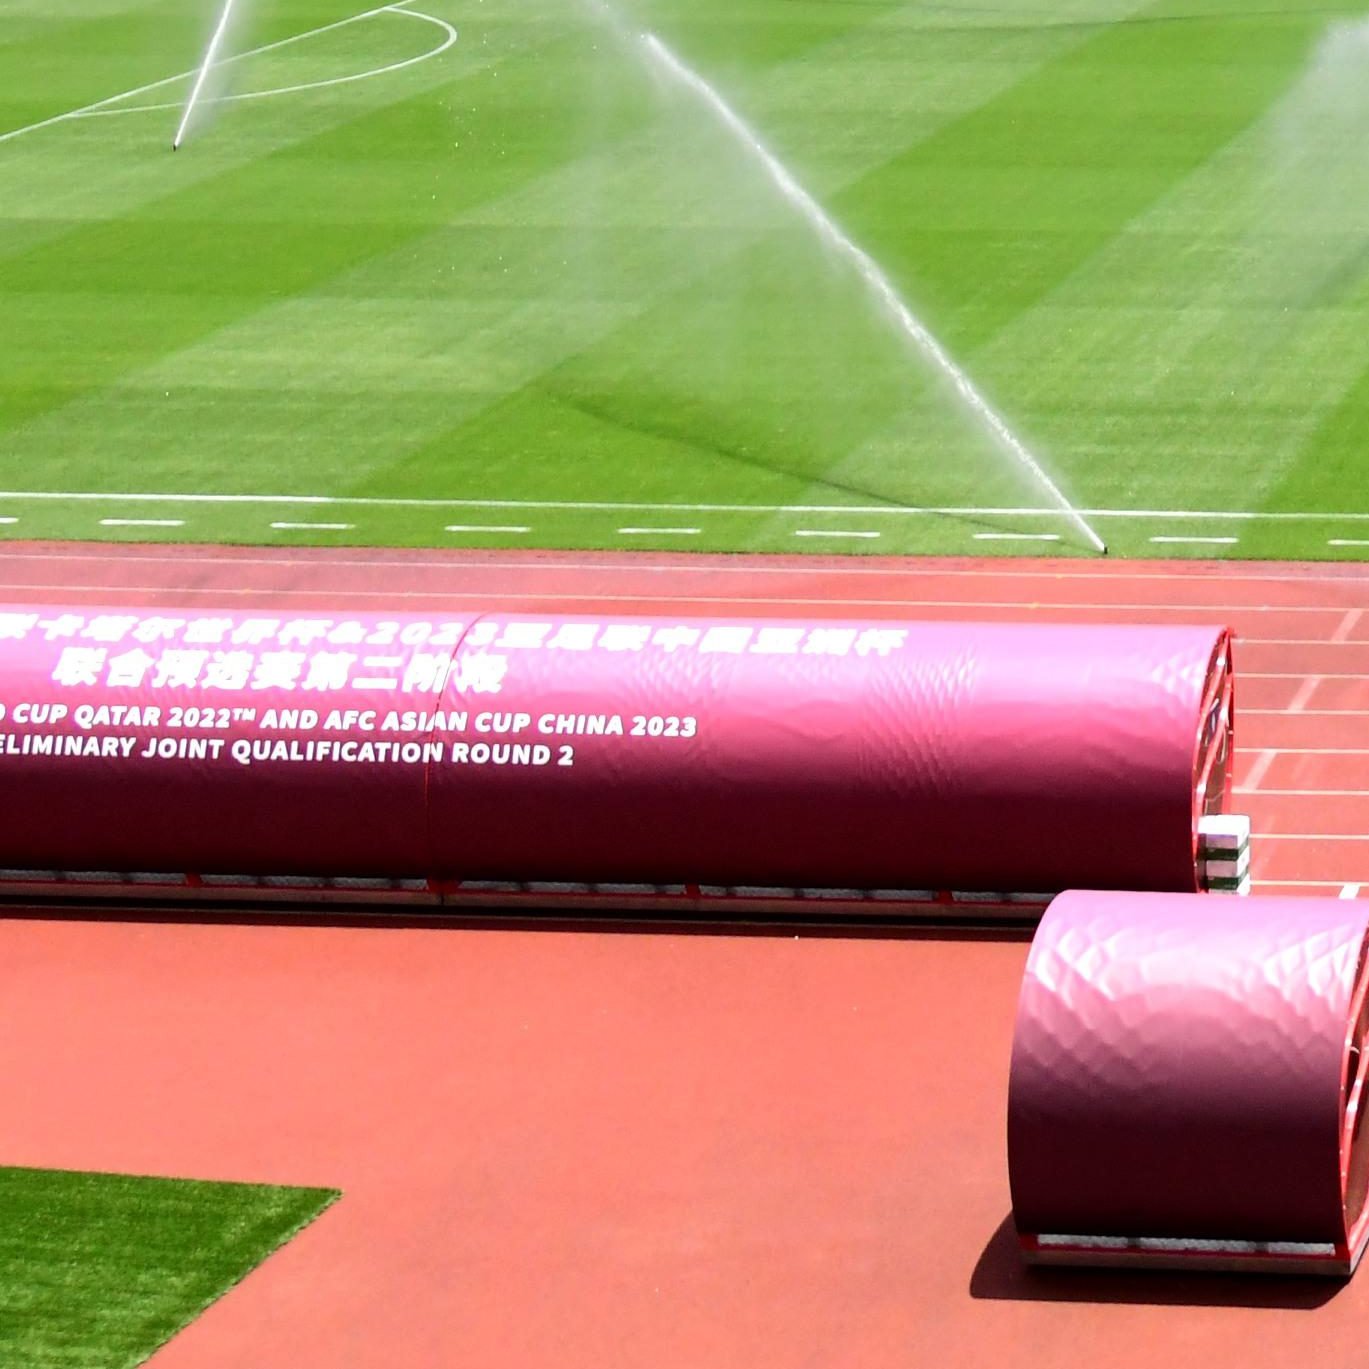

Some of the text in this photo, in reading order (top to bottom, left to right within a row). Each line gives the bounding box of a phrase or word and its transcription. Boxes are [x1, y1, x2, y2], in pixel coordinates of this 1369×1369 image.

[13, 702, 68, 724] CUP
[74, 704, 161, 730] QATAR
[260, 709, 319, 731] AND
[324, 710, 377, 731] AFC
[381, 711, 468, 733] ASIAN
[475, 712, 531, 734] CUP
[537, 714, 624, 736] CHINA
[630, 715, 697, 738] 2023
[142, 736, 224, 760] JOINT
[231, 739, 443, 765] QUALIFICATION
[451, 742, 550, 765] ROUND
[558, 744, 574, 767] 2
